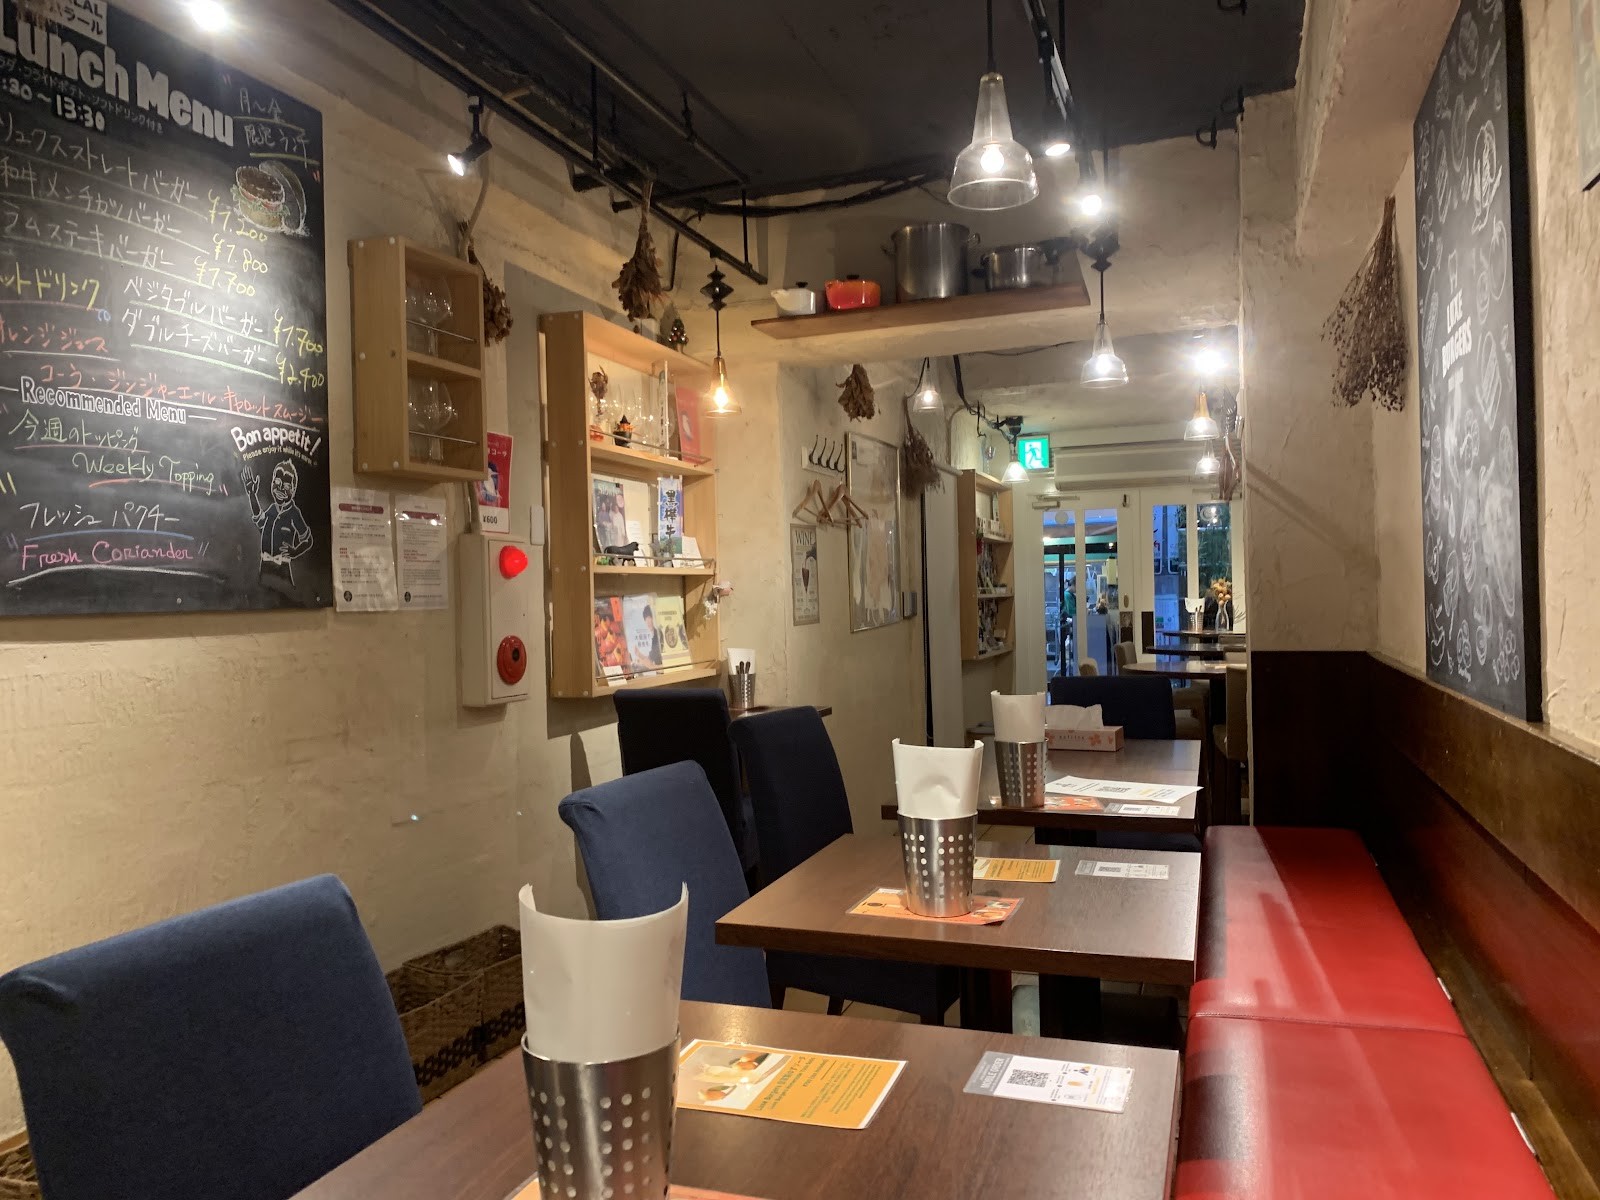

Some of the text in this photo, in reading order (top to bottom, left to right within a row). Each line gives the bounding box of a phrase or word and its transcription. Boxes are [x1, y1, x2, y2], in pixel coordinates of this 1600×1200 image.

[0, 0, 234, 148] Lunch Menu
[20, 375, 187, 425] Recommended Menu
[8, 408, 140, 453] 今週のトッピング
[230, 426, 262, 452] Bon
[242, 448, 262, 461] Please
[262, 445, 277, 454] enjoy
[72, 452, 215, 496] Weekly Topping
[483, 514, 498, 525] ¥600
[22, 540, 194, 571] Fresh Coriander
